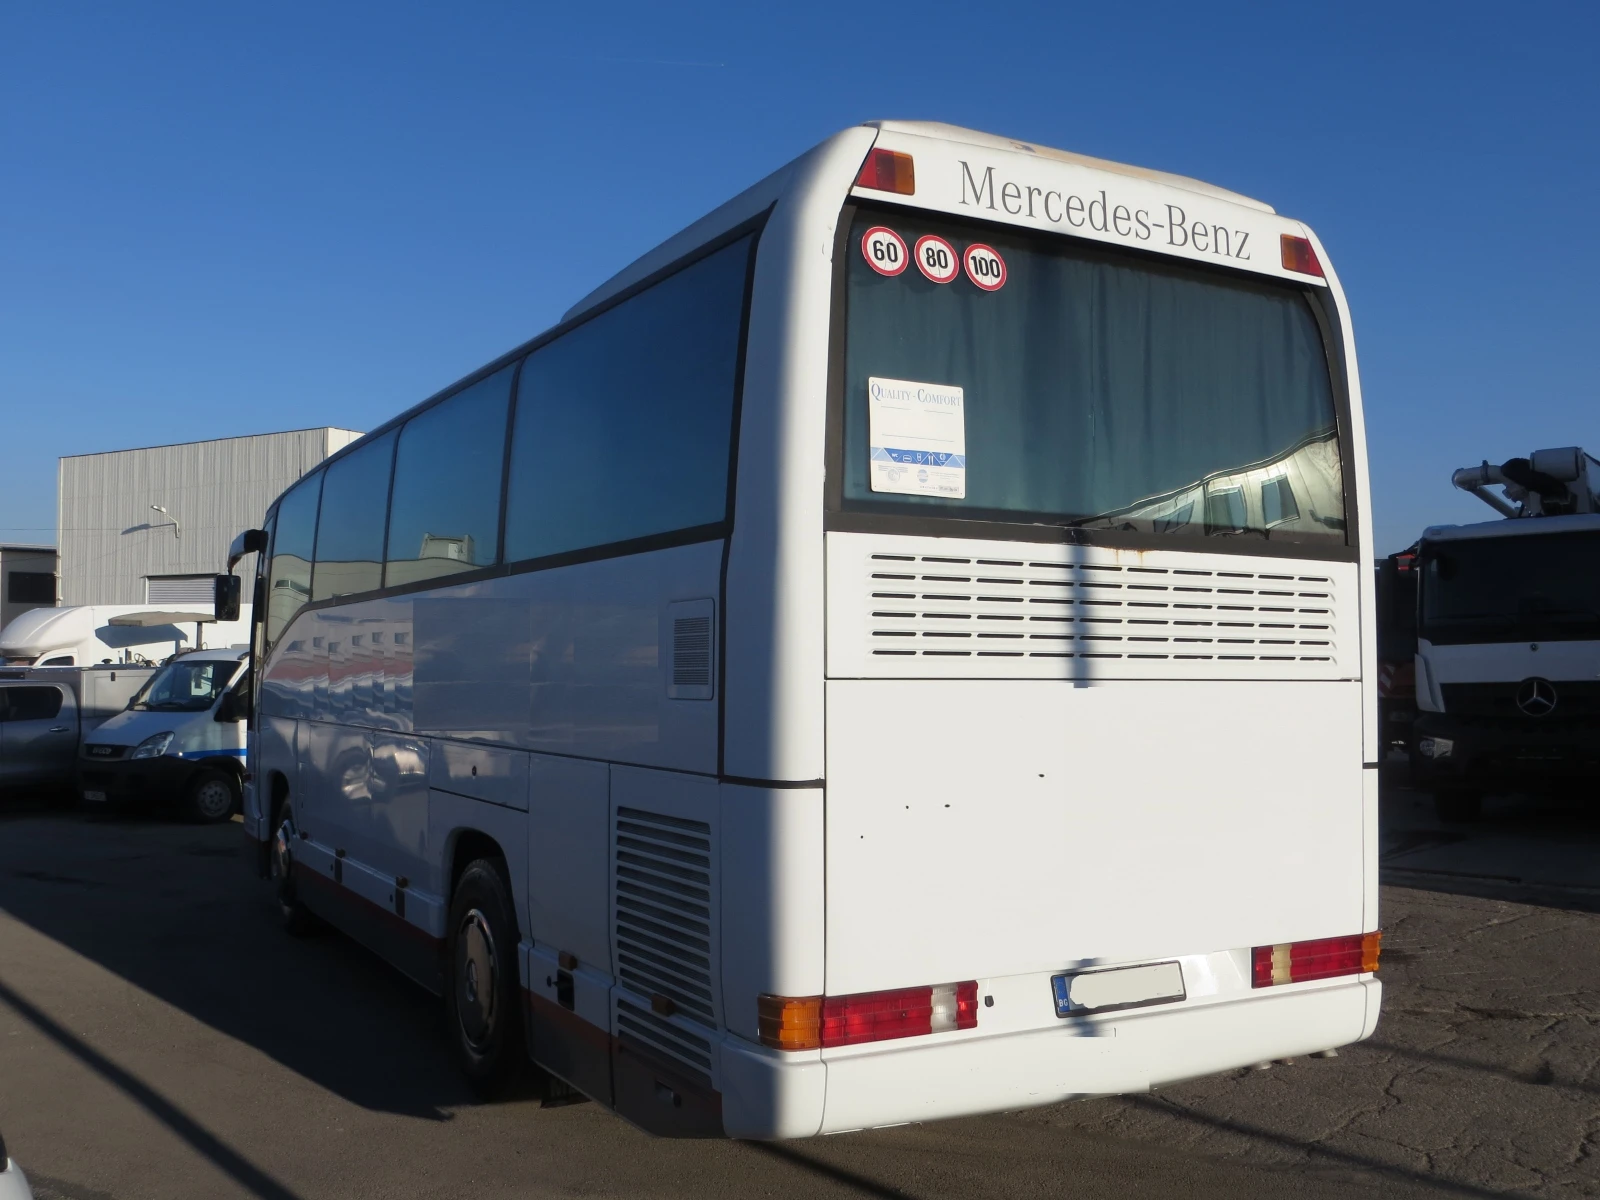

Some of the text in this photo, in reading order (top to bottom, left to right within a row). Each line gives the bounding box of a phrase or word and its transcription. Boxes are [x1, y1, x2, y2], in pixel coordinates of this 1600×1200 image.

[958, 160, 1251, 260] Mercedes-Benz
[871, 240, 898, 264] 60
[925, 248, 948, 270] 80
[970, 256, 1001, 278] 100
[1058, 998, 1068, 1007] BG
